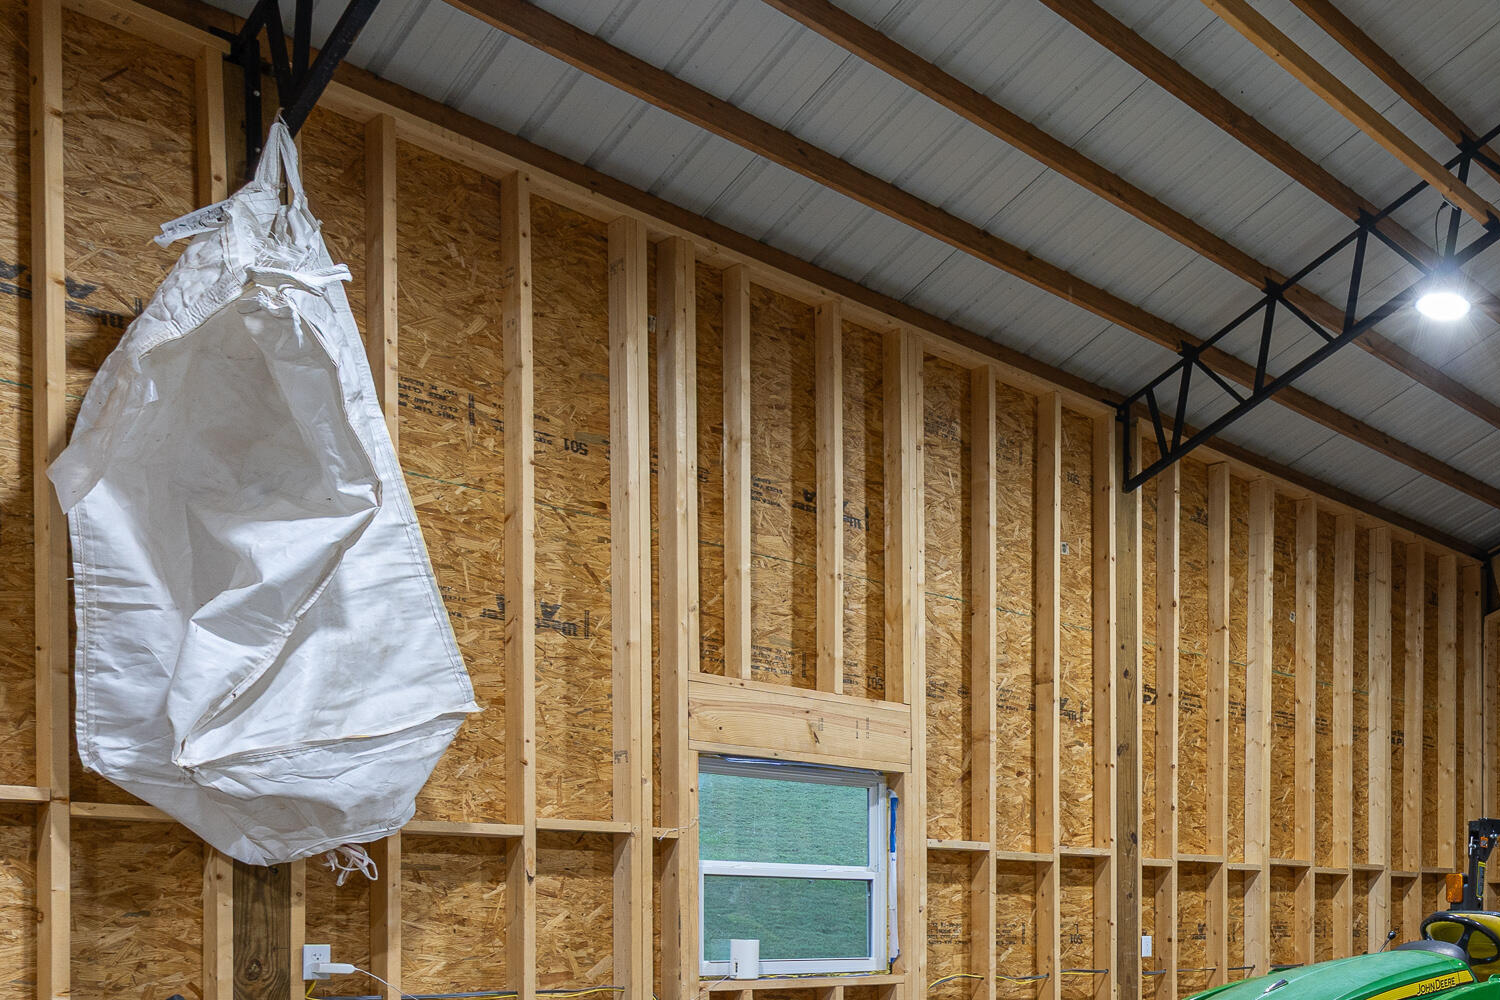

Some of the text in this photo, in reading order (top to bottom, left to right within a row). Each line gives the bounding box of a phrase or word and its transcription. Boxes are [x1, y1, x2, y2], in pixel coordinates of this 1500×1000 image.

[563, 438, 589, 456] 501
[1417, 977, 1456, 996] JOHN DEERE
